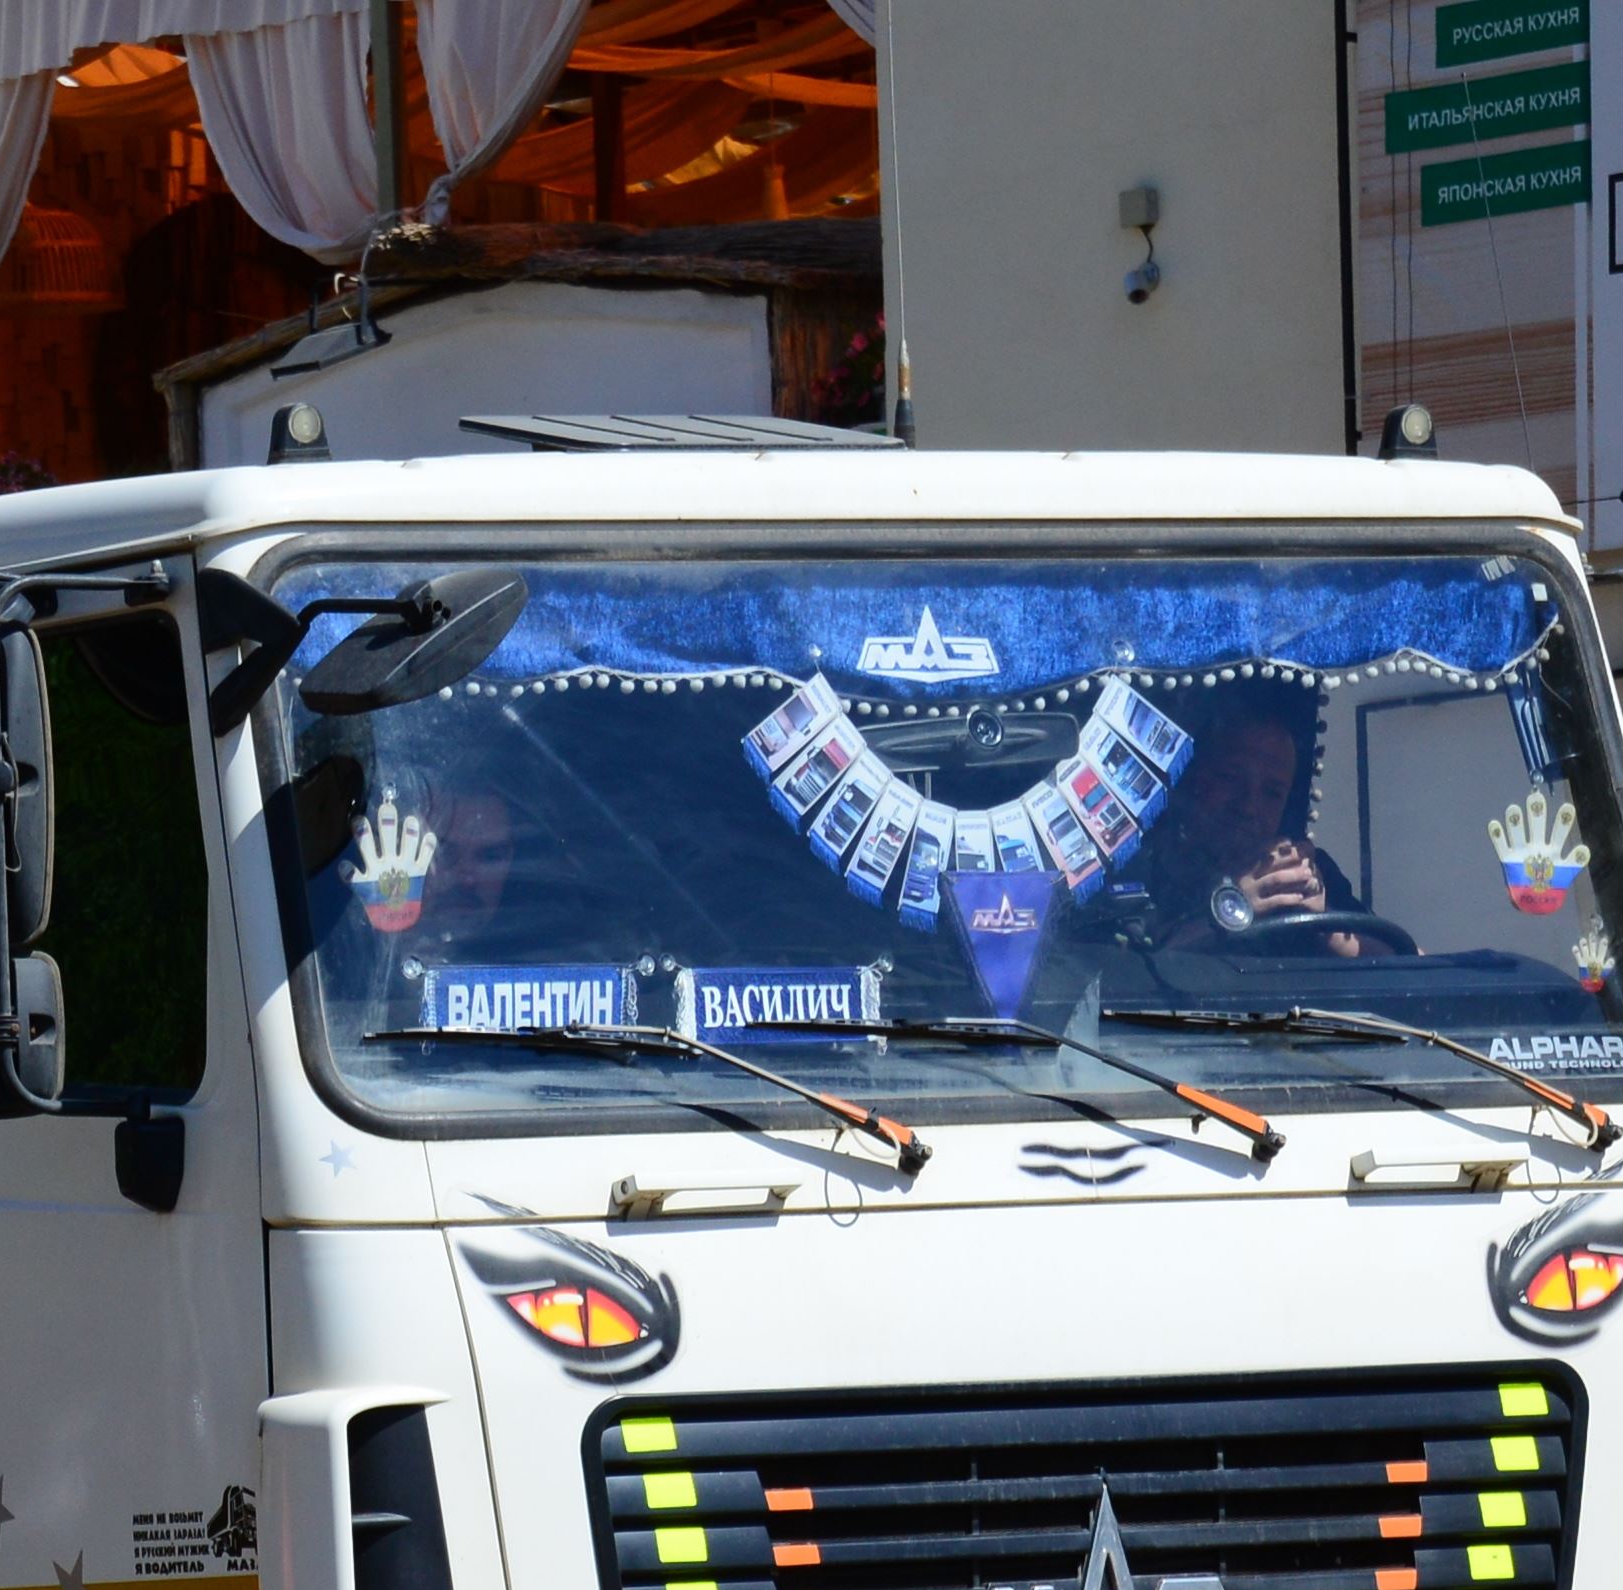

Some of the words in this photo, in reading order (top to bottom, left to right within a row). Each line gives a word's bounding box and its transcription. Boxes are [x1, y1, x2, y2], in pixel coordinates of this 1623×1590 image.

[1452, 16, 1524, 46] РУССКАЯ
[1527, 7, 1580, 32] КУХНЯ
[1408, 97, 1525, 131] ИТАЛЬЯНСКАЯ
[1529, 87, 1581, 111] КУХНЯ
[1438, 175, 1526, 204] ЯПОНСКАЯ
[1530, 166, 1582, 190] КУХНЯ
[447, 980, 613, 1028] ВАЛЕНТИН
[702, 984, 851, 1028] ВАСИЛИЧ
[1504, 1060, 1544, 1070] OUND
[156, 1513, 167, 1524] НЕ
[135, 1563, 143, 1575] Я
[145, 1561, 205, 1575] ВОДИТЕЛЬ
[227, 1559, 258, 1571] МАЗ
[142, 1543, 177, 1557] РУССКИЙ
[178, 1544, 210, 1556] МУЖИК
